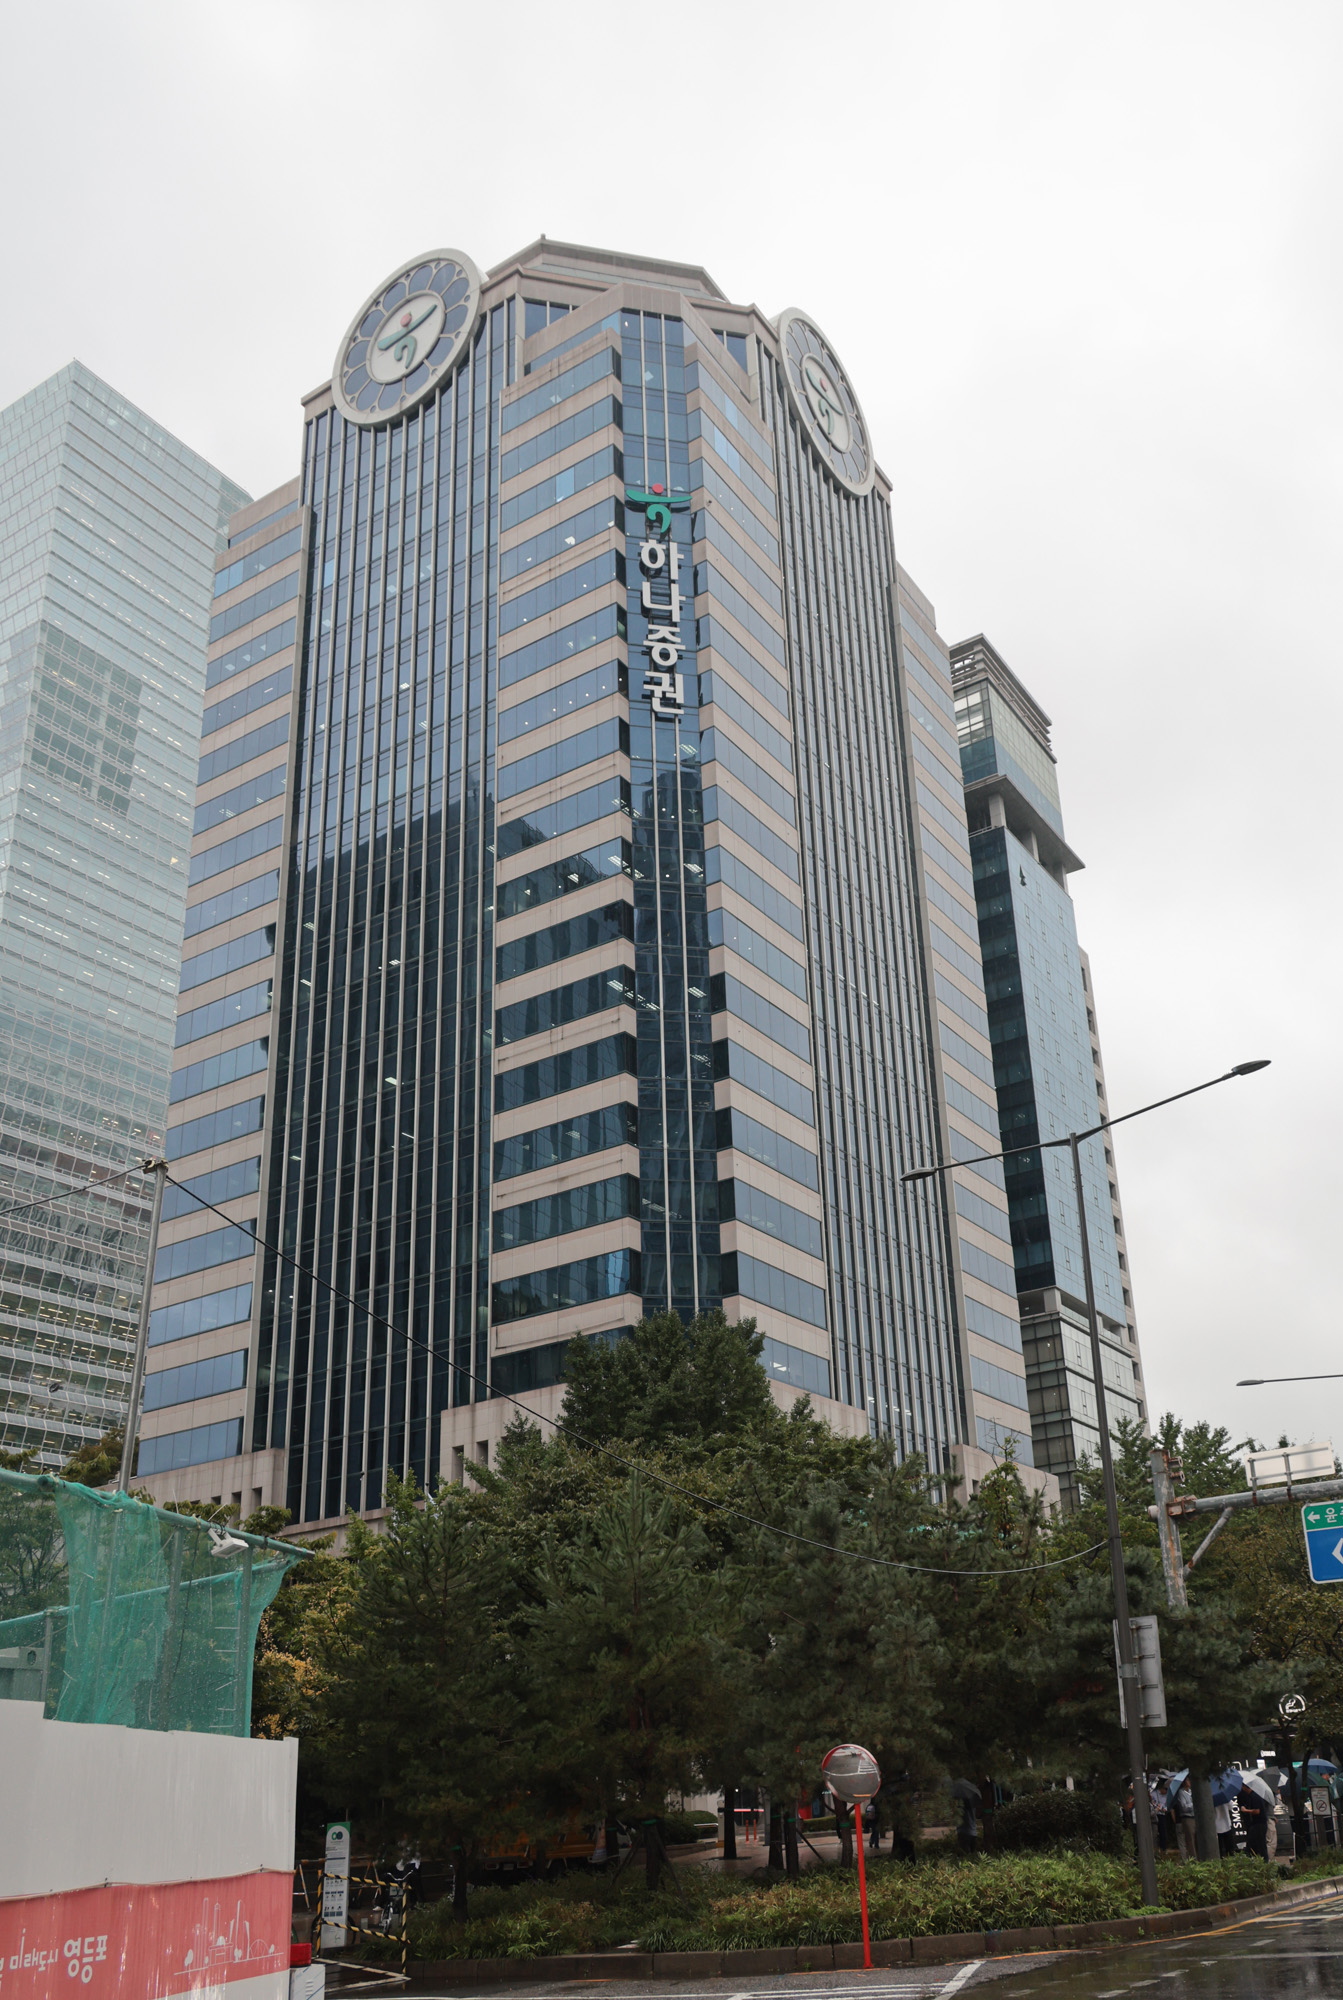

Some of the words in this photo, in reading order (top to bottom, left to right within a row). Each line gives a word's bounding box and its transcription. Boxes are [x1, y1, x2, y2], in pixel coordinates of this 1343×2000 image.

[639, 539, 686, 715] 하나증권
[1324, 1506, 1343, 1523] 윤
[9, 1928, 58, 1972] 미래도시
[63, 1934, 108, 1984] 영등포
